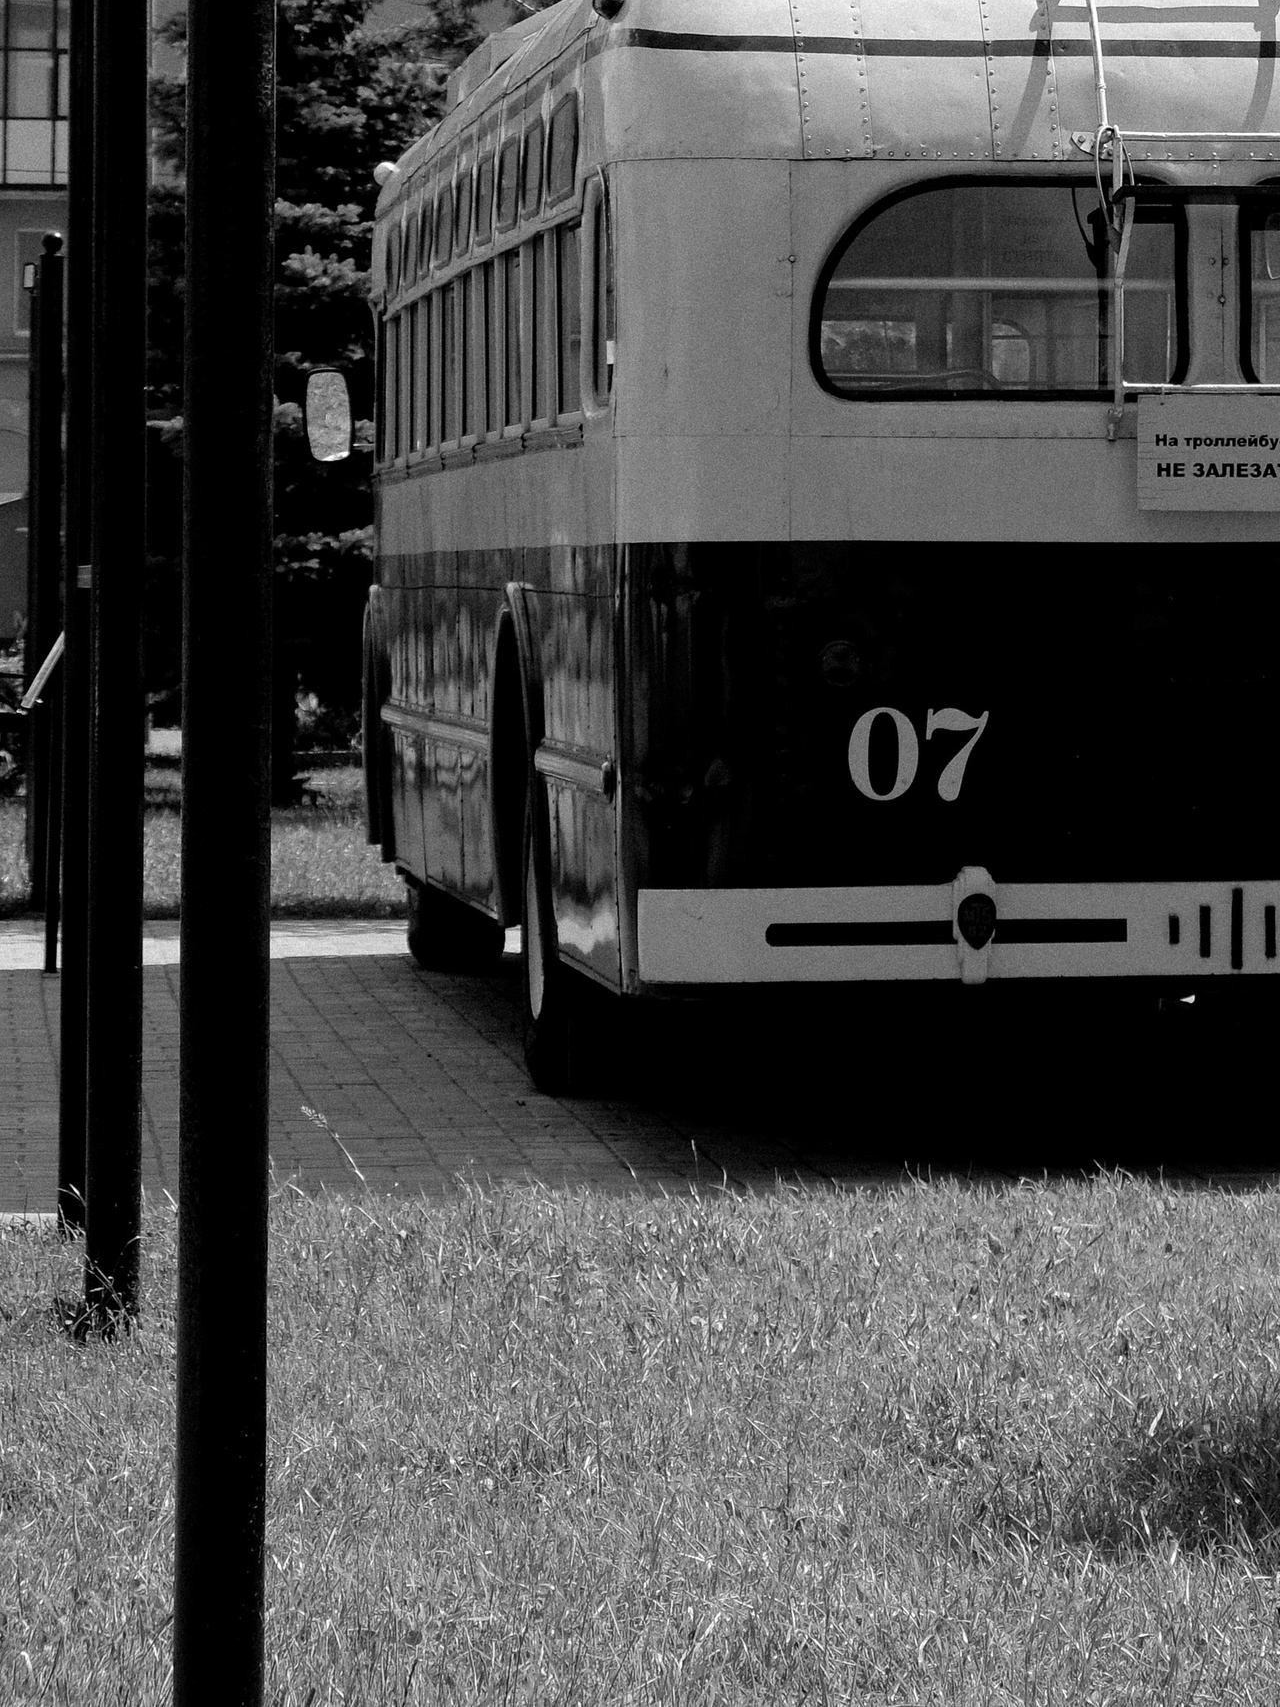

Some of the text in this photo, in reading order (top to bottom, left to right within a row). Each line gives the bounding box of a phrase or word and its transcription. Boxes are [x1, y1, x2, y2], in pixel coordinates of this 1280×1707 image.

[1155, 434, 1179, 447] На
[1156, 462, 1186, 478] НЕ
[848, 706, 990, 802] 07
